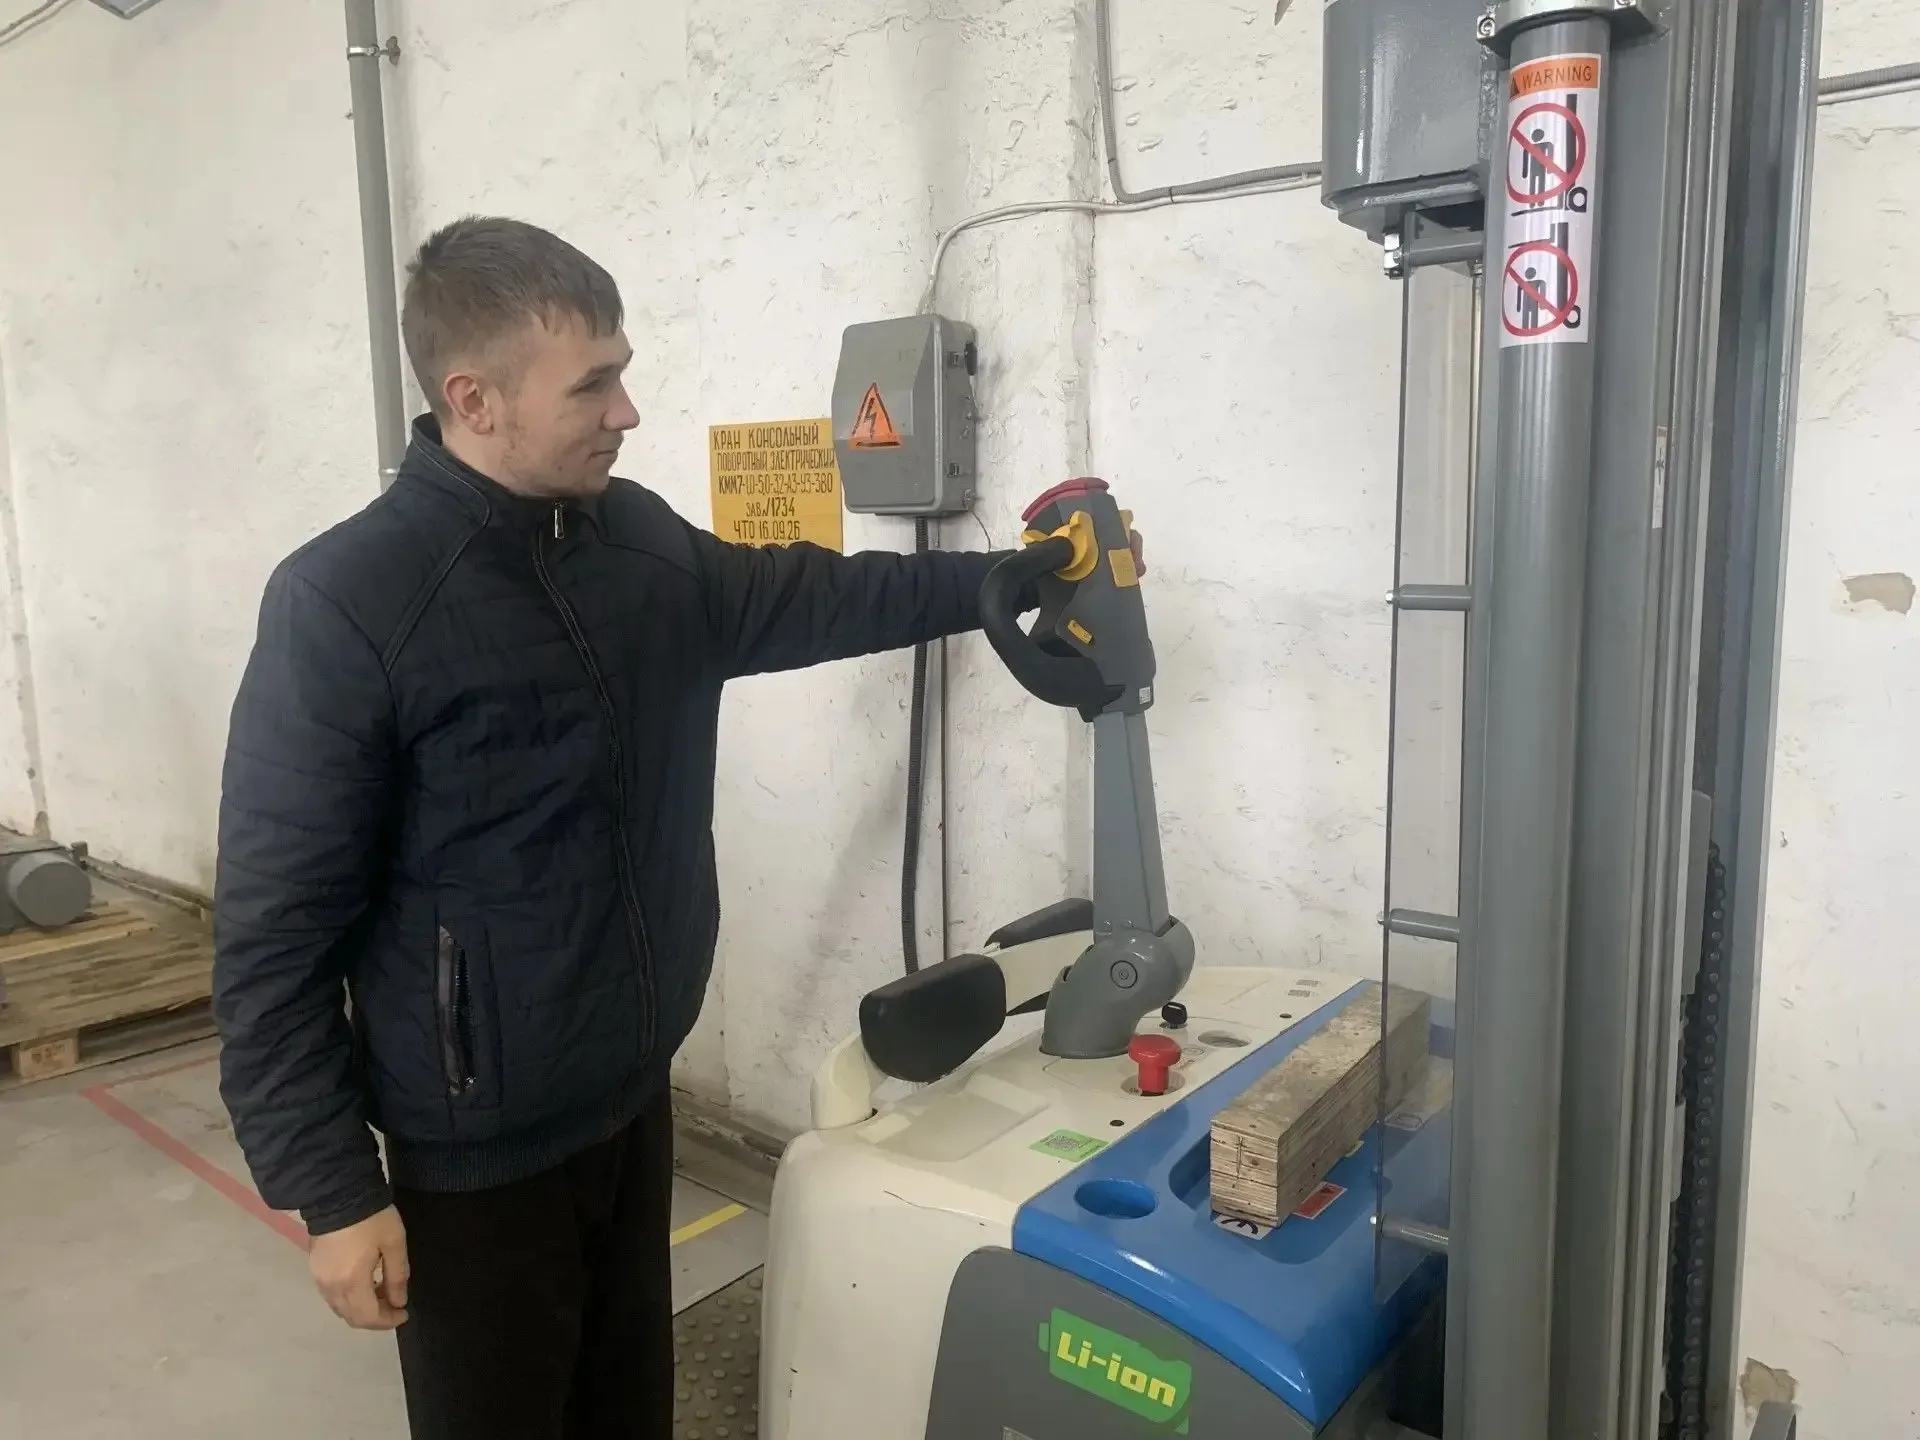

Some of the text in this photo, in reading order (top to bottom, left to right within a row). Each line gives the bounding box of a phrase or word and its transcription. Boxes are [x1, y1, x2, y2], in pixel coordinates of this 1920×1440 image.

[1523, 65, 1592, 88] WARNING
[713, 423, 819, 450] КРАН КОНСОЛЬНЫЙ
[717, 448, 835, 472] ПОВОРОТНЫЙ ЭЛЕКТРИЧЕСКИЙ
[733, 520, 755, 540] ЧТО
[1057, 1331, 1177, 1408] Li-ion
